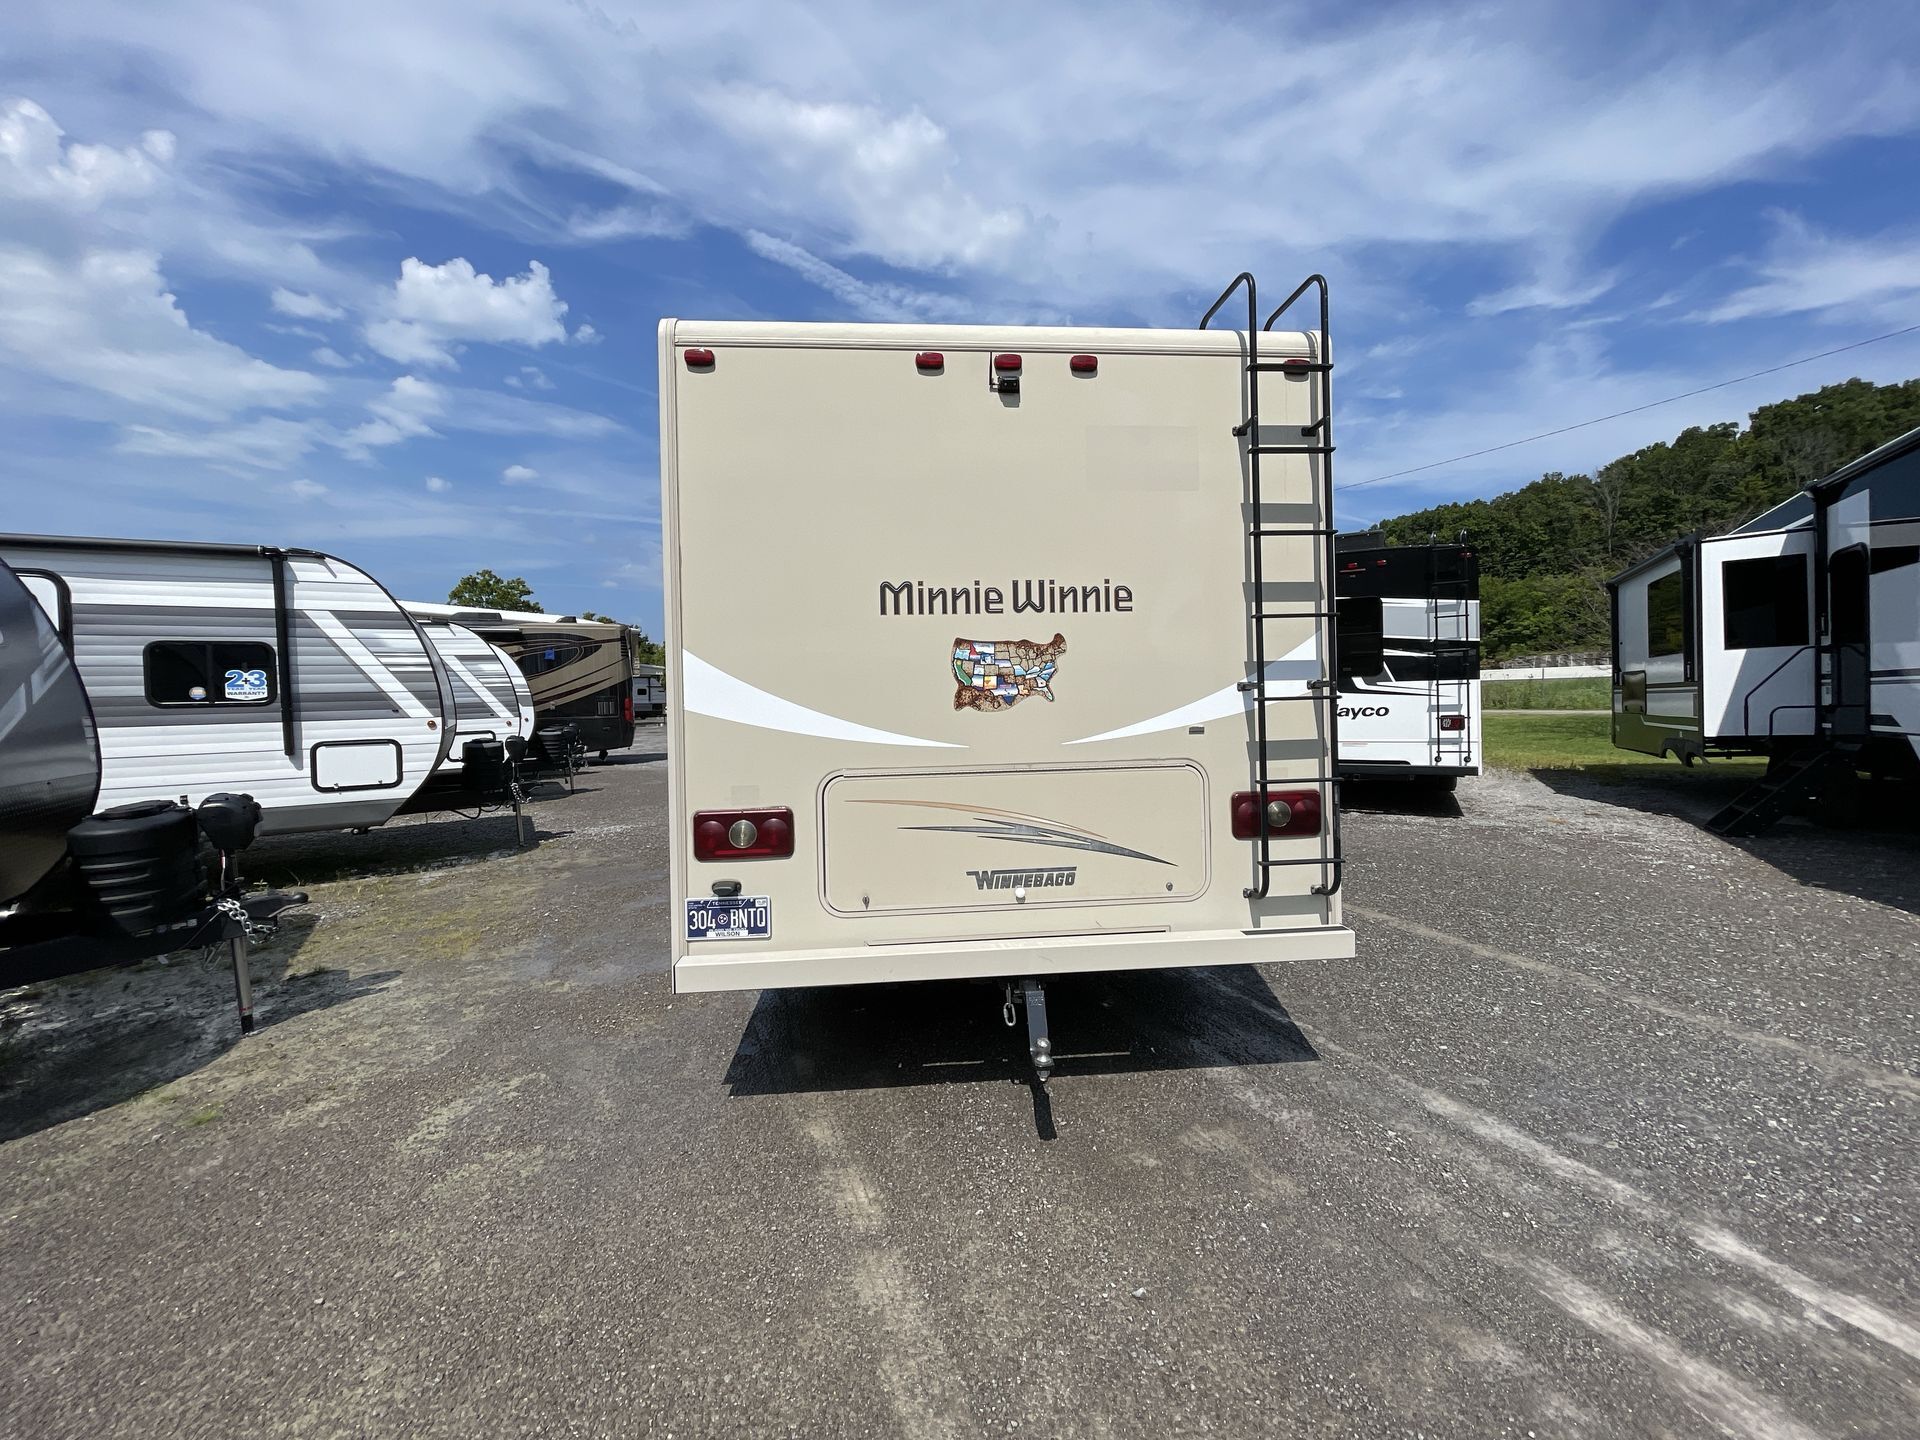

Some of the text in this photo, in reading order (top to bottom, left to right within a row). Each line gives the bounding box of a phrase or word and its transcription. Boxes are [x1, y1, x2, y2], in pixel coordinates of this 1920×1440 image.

[880, 579, 1133, 615] Minnie Winnie
[1337, 704, 1390, 720] ayco
[966, 866, 1077, 890] WINNEBAGO
[689, 908, 766, 930] 304 BNTQ
